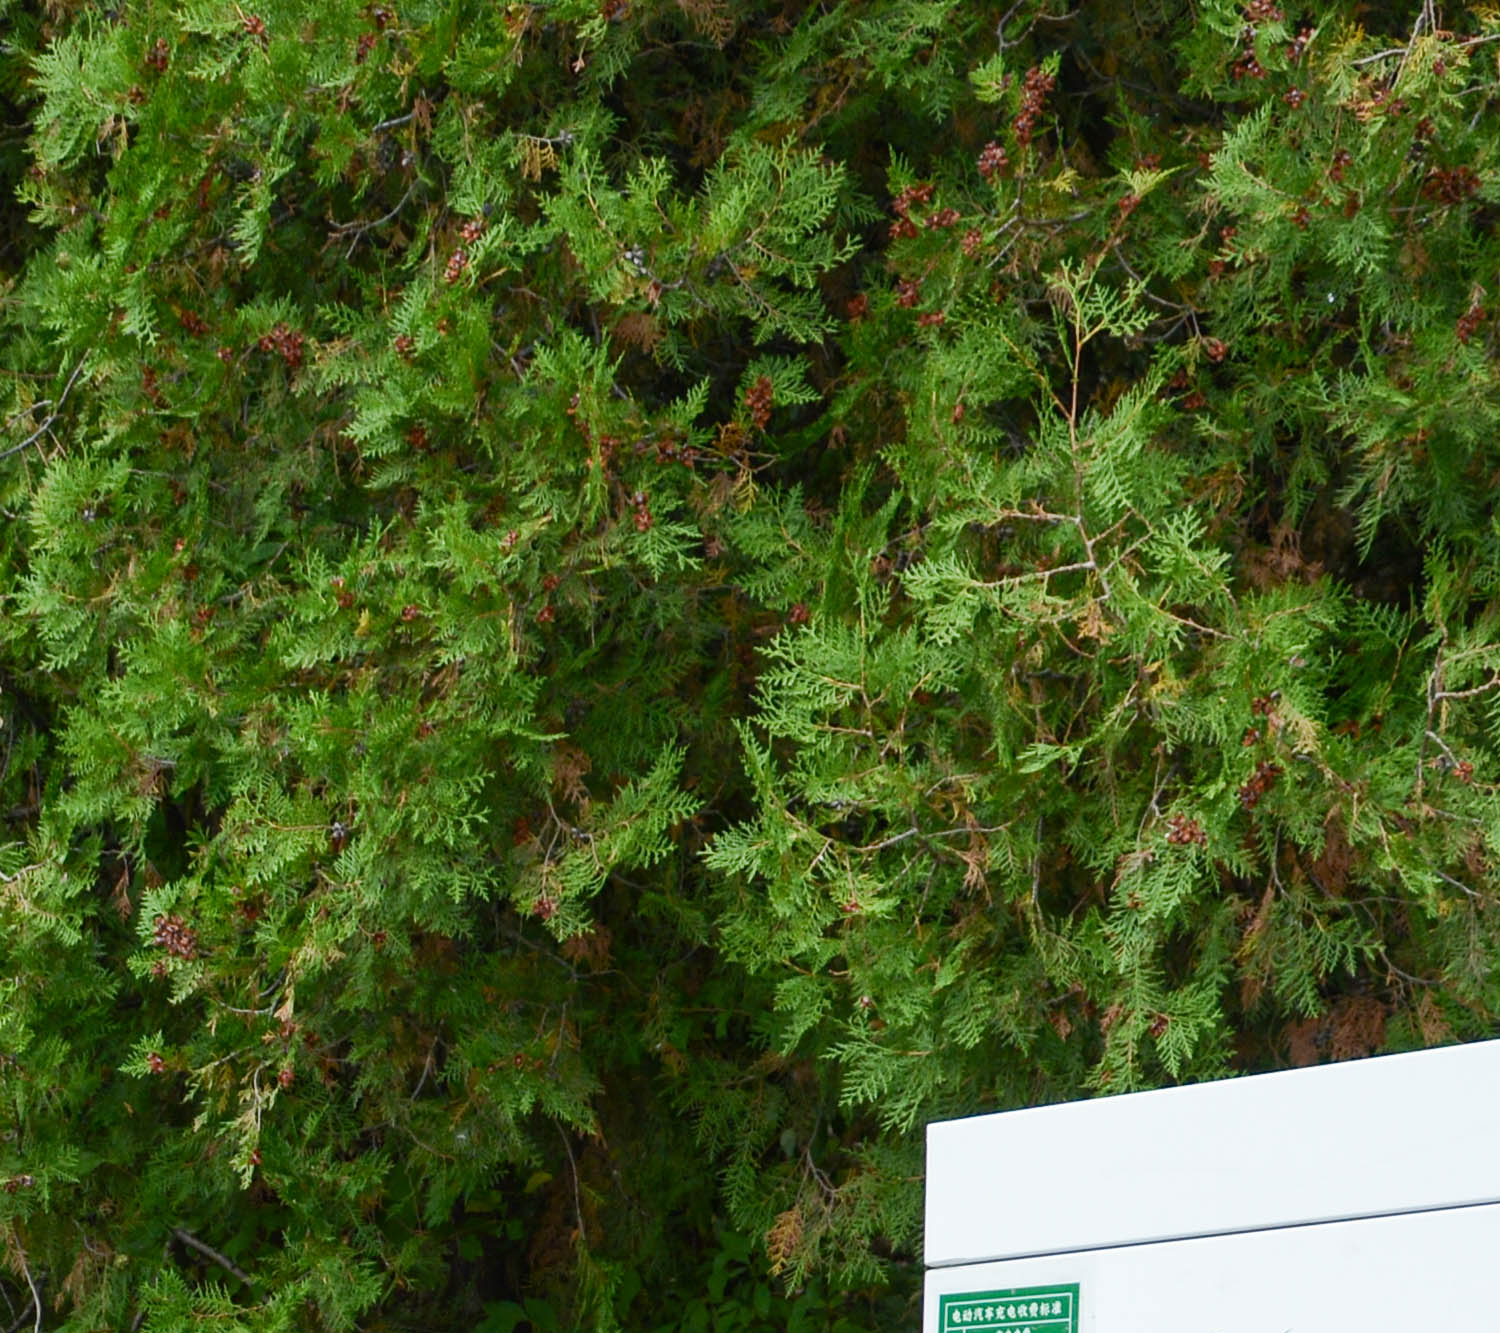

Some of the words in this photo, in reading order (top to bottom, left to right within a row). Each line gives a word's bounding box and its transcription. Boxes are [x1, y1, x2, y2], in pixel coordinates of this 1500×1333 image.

[952, 1300, 1062, 1323] 电动汽车充电收费标准
